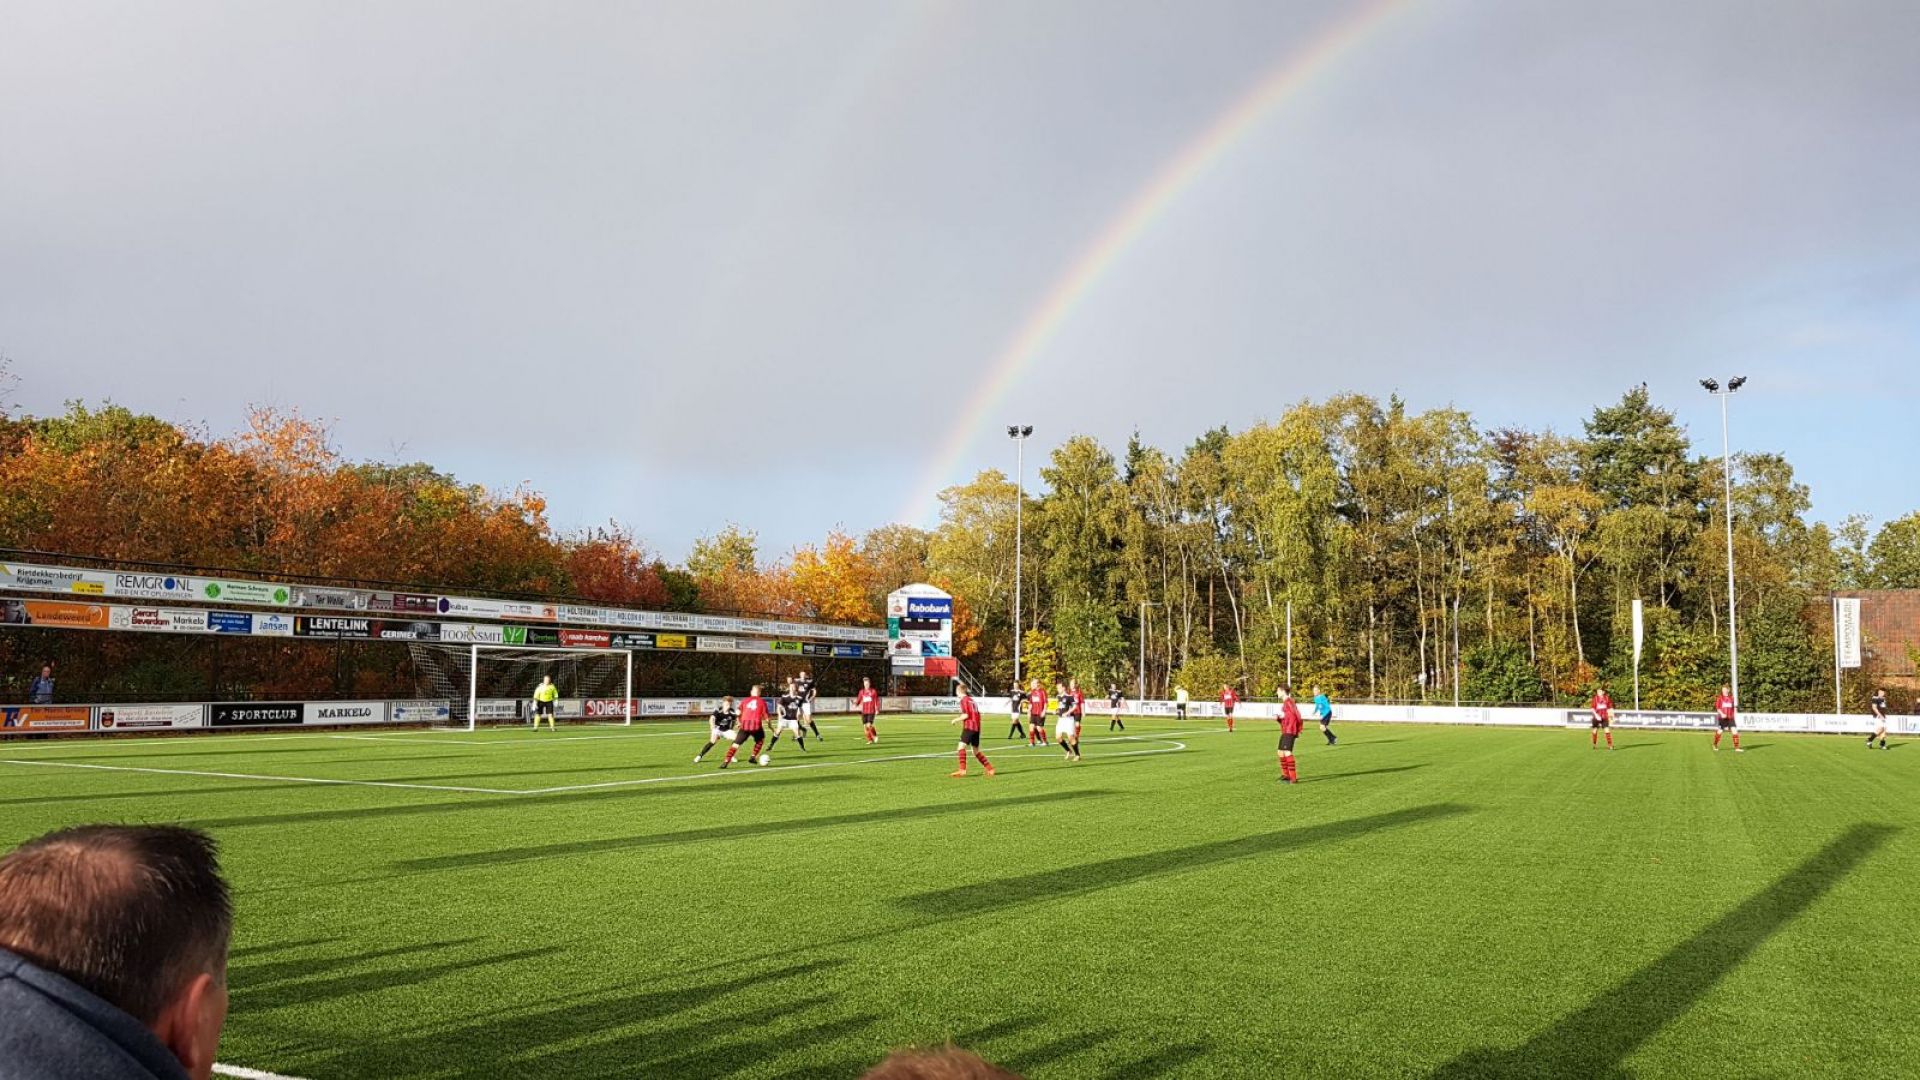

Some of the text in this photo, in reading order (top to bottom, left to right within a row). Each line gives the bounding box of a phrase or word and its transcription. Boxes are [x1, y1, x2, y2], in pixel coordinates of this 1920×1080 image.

[150, 590, 193, 599] OPLOSSINGEN
[132, 607, 159, 617] Gerard
[909, 603, 950, 613] Rabobank
[131, 616, 170, 626] Beverdam
[173, 616, 205, 625] Markelo
[259, 620, 289, 631] Jansen
[309, 617, 369, 631] LENTELINK
[380, 630, 418, 639] CERIMEX
[568, 633, 609, 642] raab karcher
[745, 699, 758, 711] 4
[231, 709, 298, 720] SPORTCLUB
[317, 707, 372, 719] MARKELO
